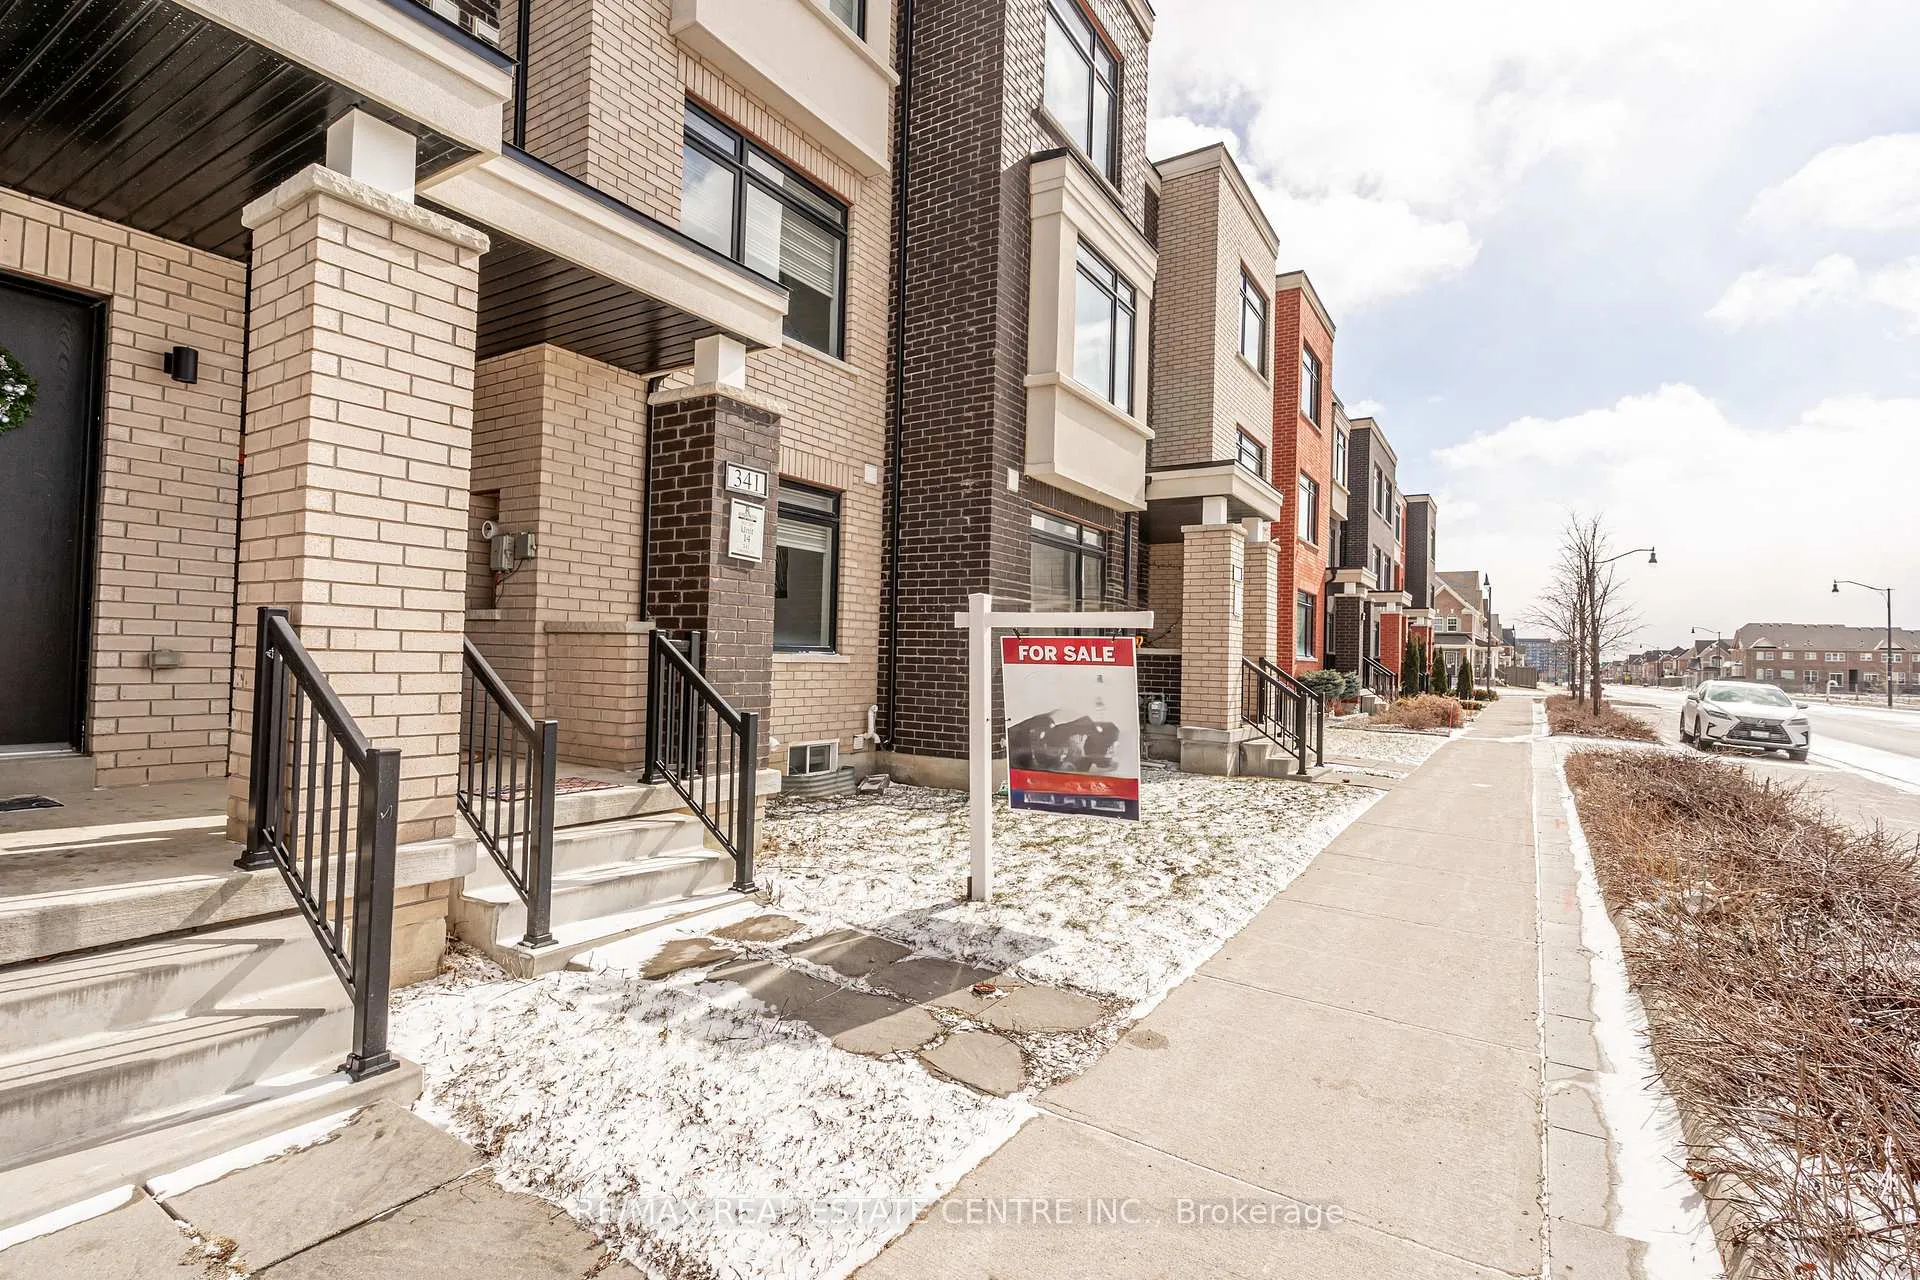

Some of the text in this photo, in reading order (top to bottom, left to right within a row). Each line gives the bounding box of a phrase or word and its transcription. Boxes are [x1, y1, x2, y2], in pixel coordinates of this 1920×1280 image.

[733, 469, 759, 492] 341
[740, 526, 754, 535] Unit
[1018, 645, 1116, 663] FOR SALE
